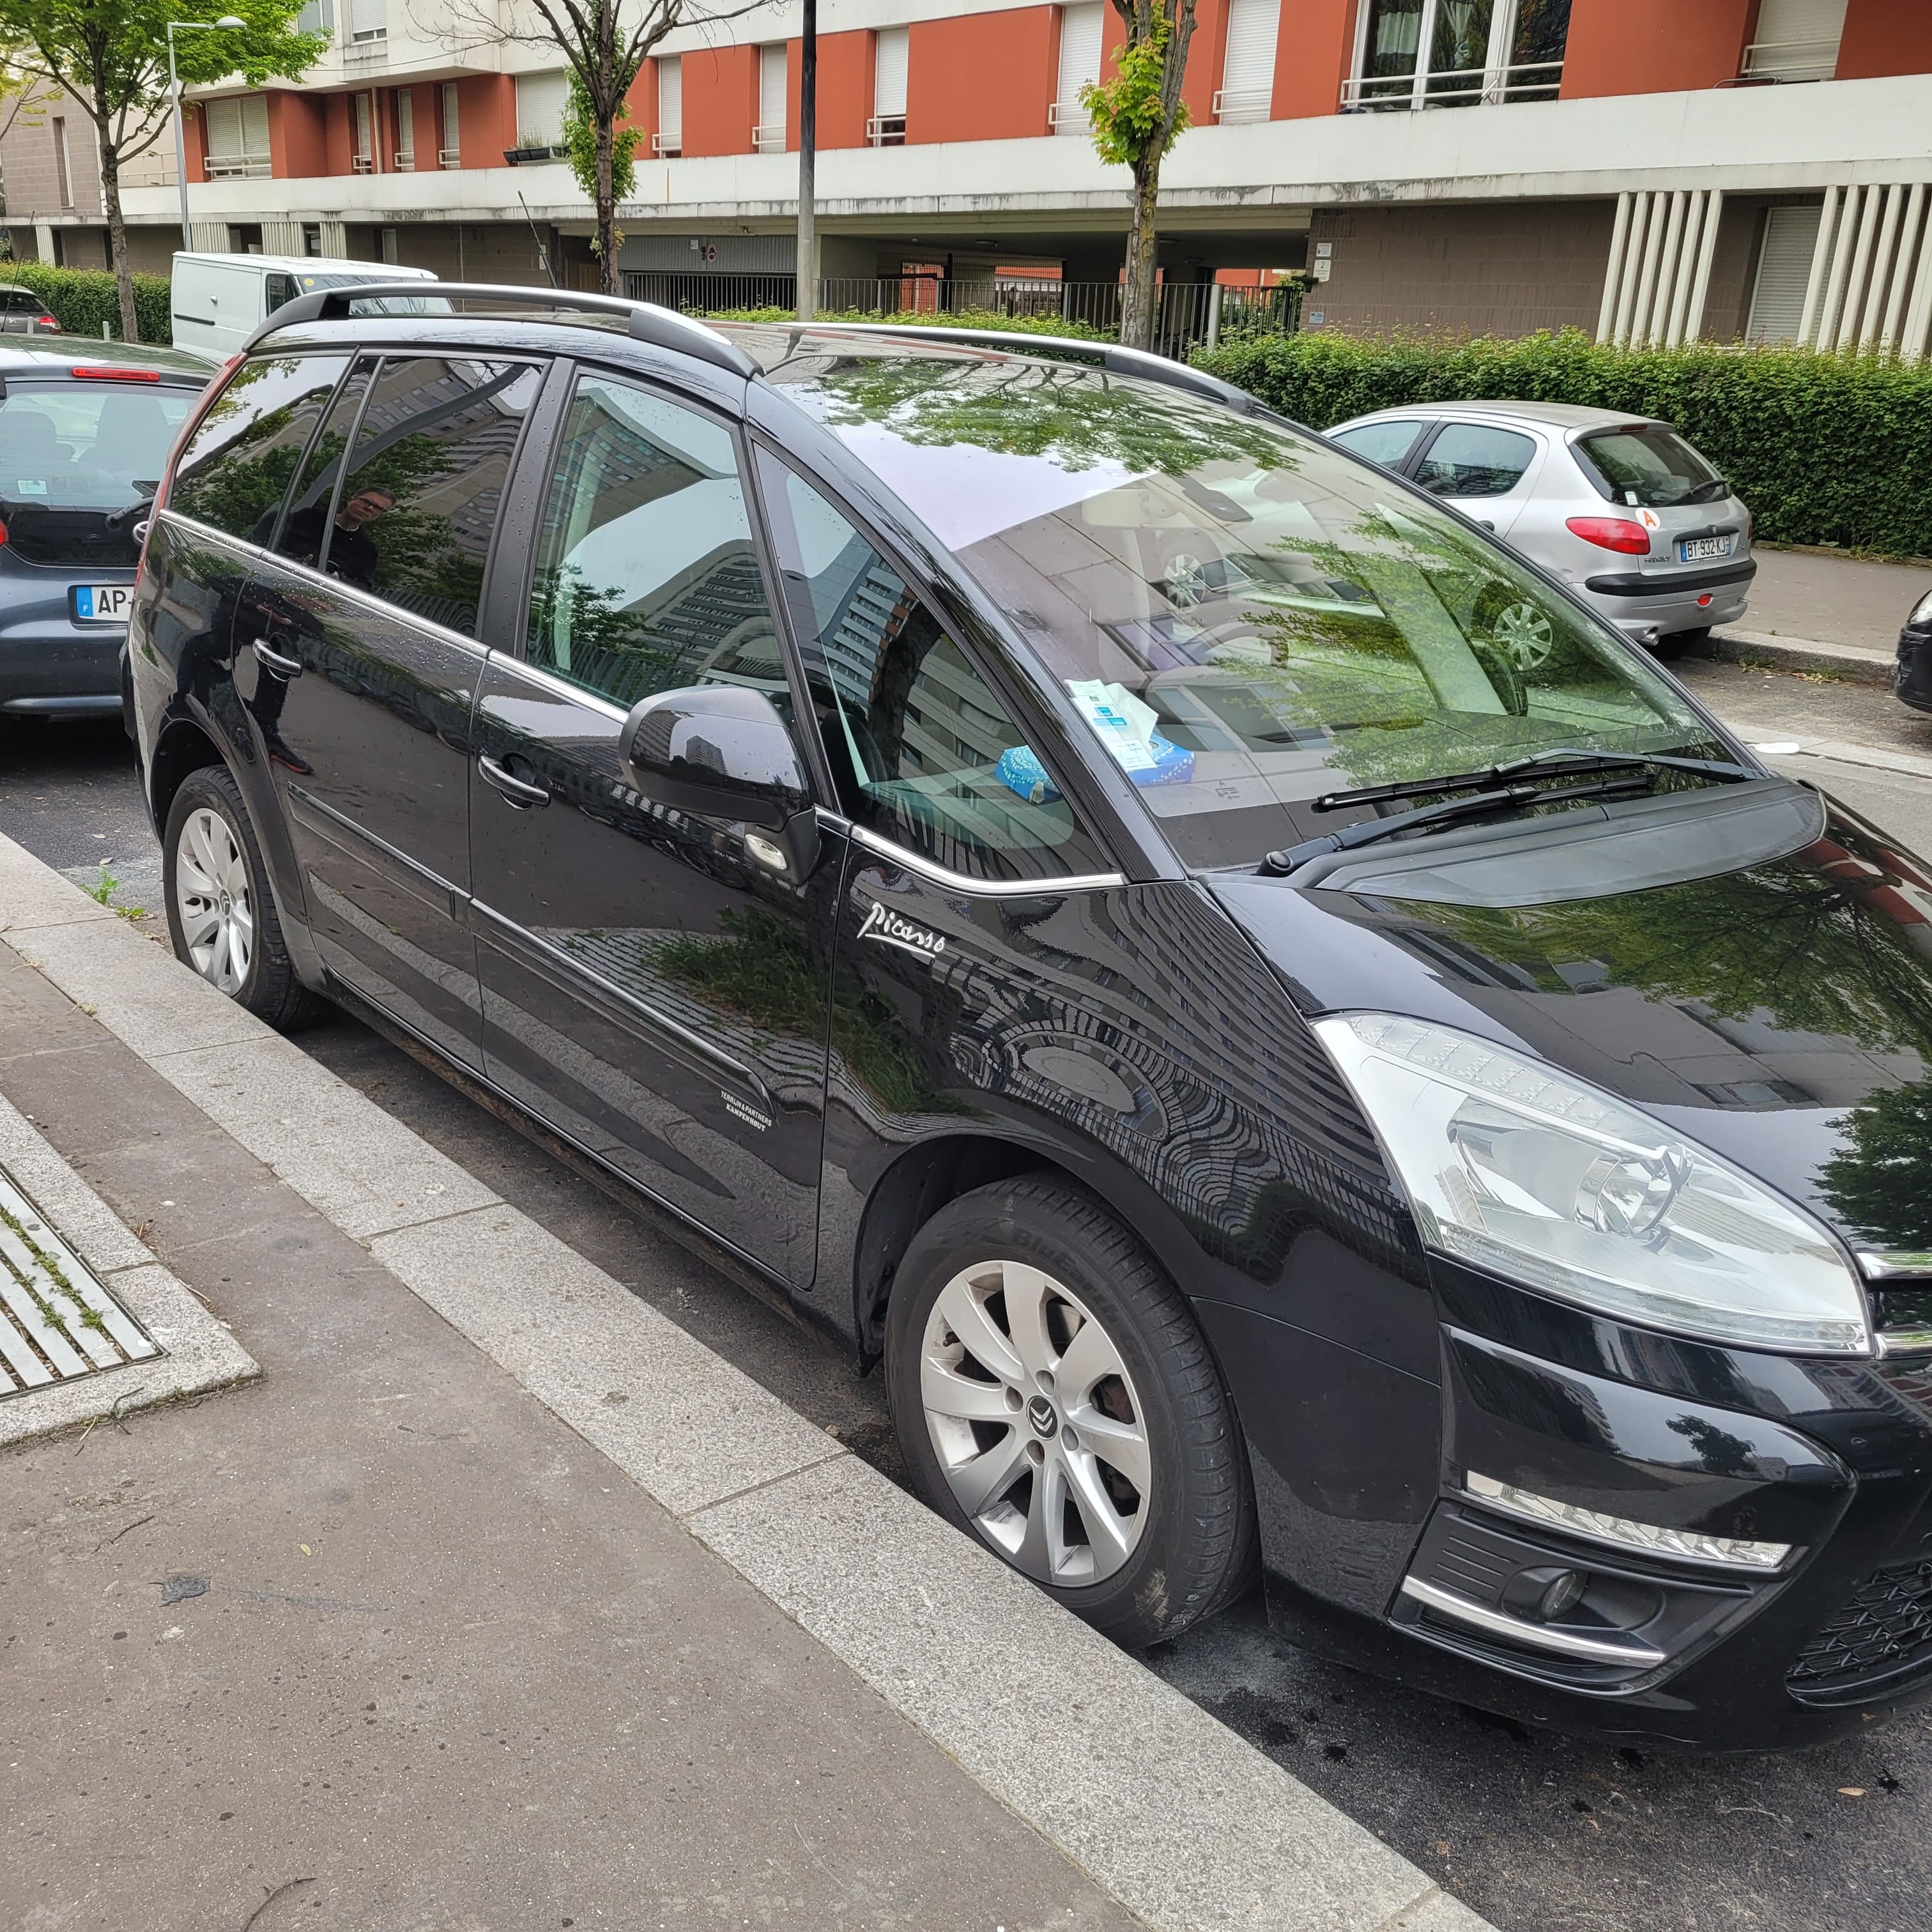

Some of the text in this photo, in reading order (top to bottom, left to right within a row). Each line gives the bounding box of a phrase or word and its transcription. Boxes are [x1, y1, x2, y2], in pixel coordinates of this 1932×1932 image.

[1320, 261, 1324, 269] 2
[1643, 510, 1657, 527] A
[856, 901, 946, 953] Picasso
[726, 1103, 766, 1132] KAMPENHOUT
[745, 1105, 772, 1127] PARTNERS
